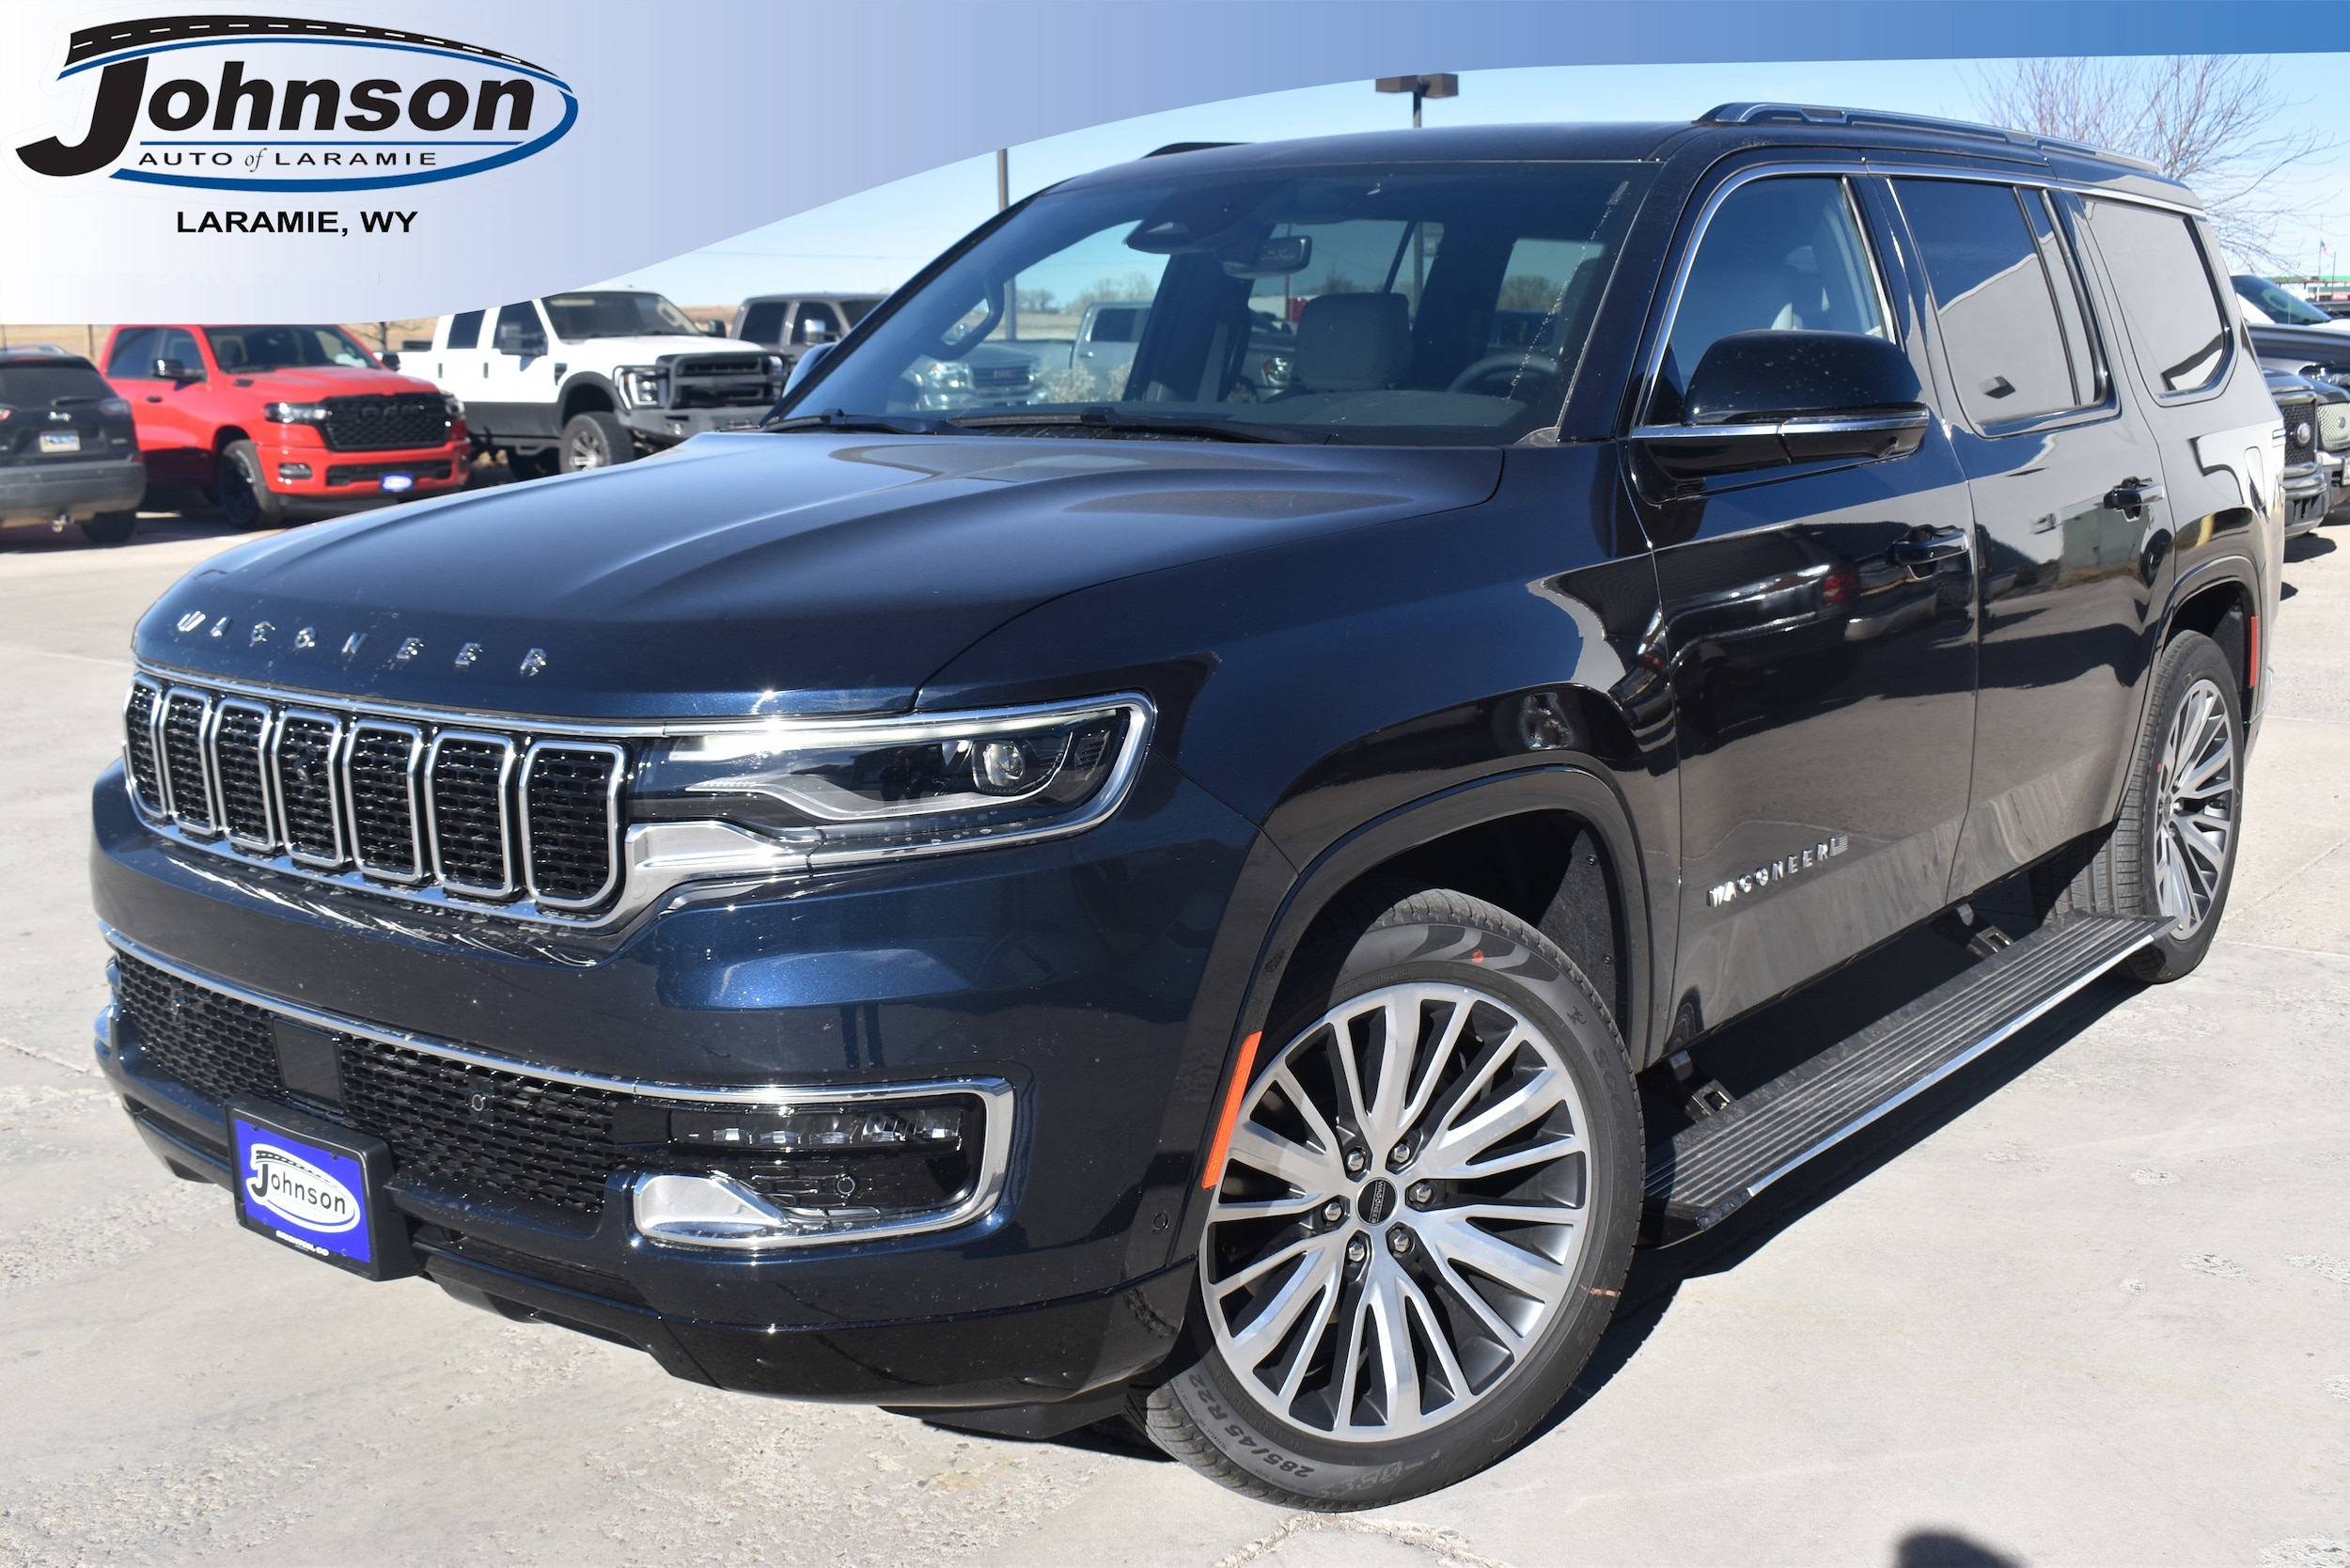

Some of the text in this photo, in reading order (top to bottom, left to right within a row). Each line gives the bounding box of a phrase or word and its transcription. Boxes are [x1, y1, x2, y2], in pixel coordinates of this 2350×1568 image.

[1706, 842, 1828, 908] WAGONEER
[250, 1163, 347, 1215] Johnson
[1188, 1372, 1230, 1421] R22
[1224, 1421, 1316, 1479] 285/45
